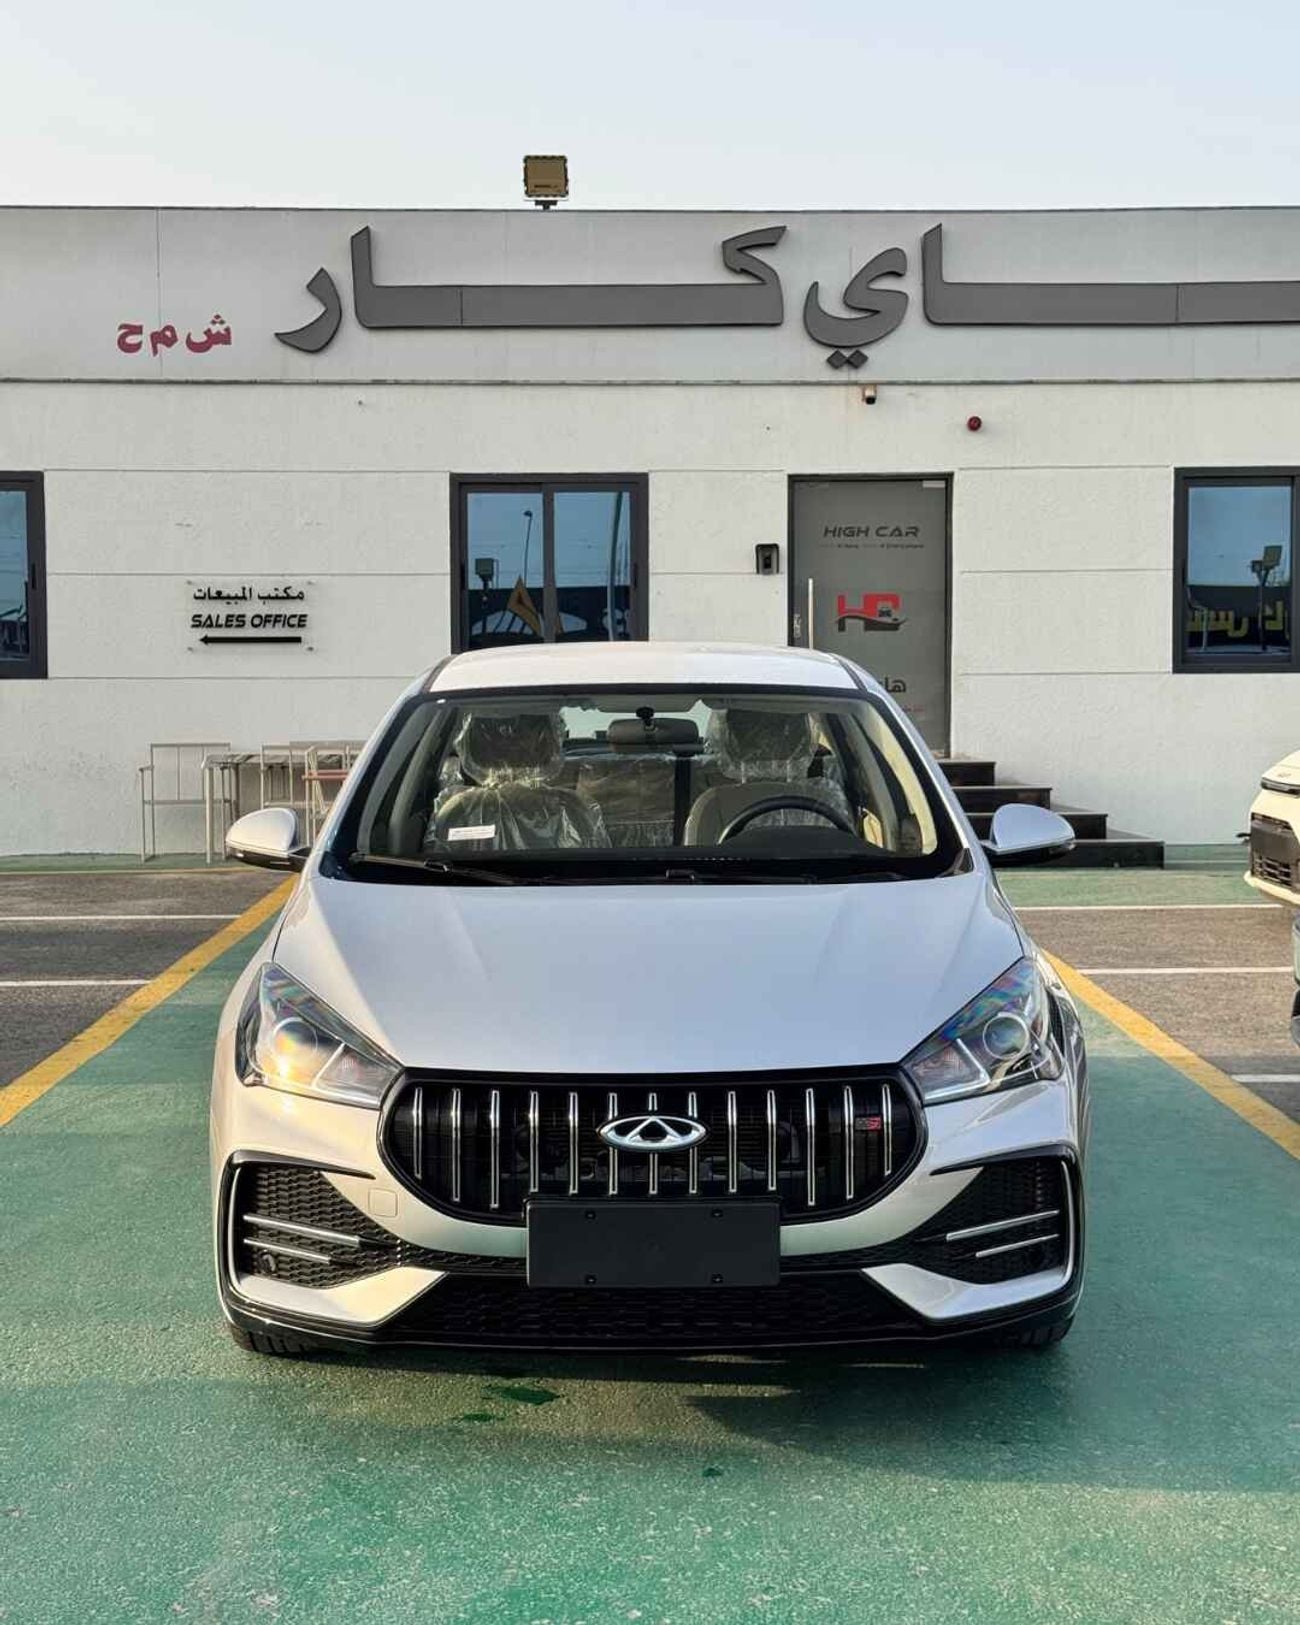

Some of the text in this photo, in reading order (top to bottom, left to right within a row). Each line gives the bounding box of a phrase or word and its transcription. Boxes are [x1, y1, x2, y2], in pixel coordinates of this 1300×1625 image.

[274, 223, 1300, 370] اي كار
[823, 525, 920, 538] HIGH CAR
[193, 586, 305, 606] مكتب المبيعات
[190, 613, 308, 629] SALES OFFICE
